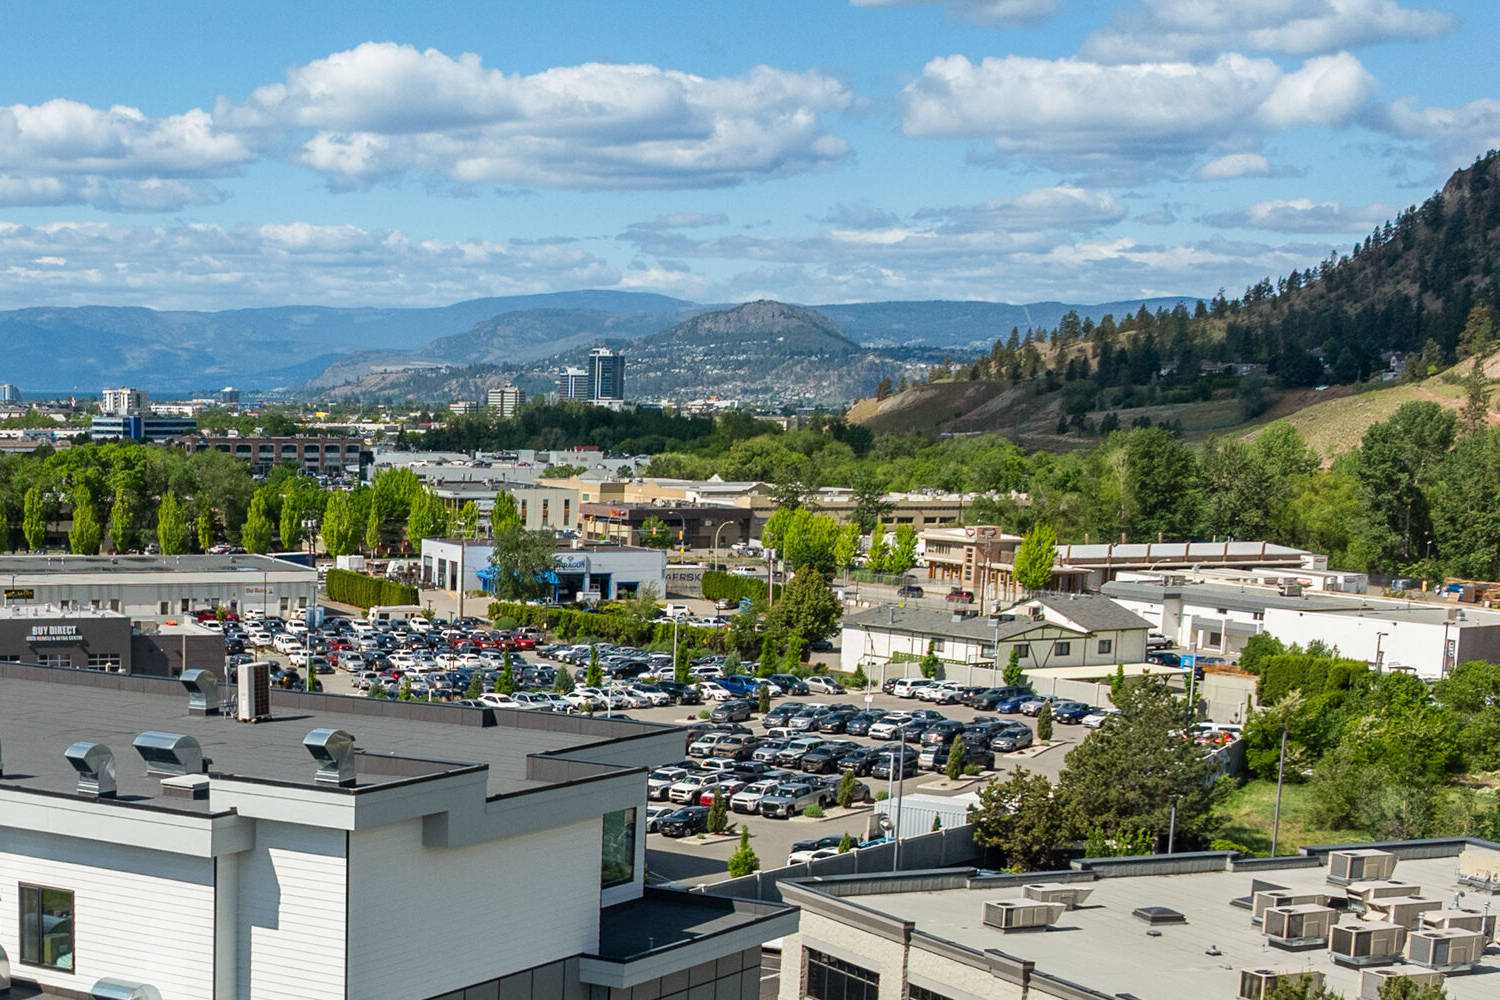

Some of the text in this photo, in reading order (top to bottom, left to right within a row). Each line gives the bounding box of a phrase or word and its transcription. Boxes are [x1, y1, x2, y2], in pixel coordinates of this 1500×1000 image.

[665, 573, 702, 581] AERSK
[32, 625, 77, 636] BUY DIRECT
